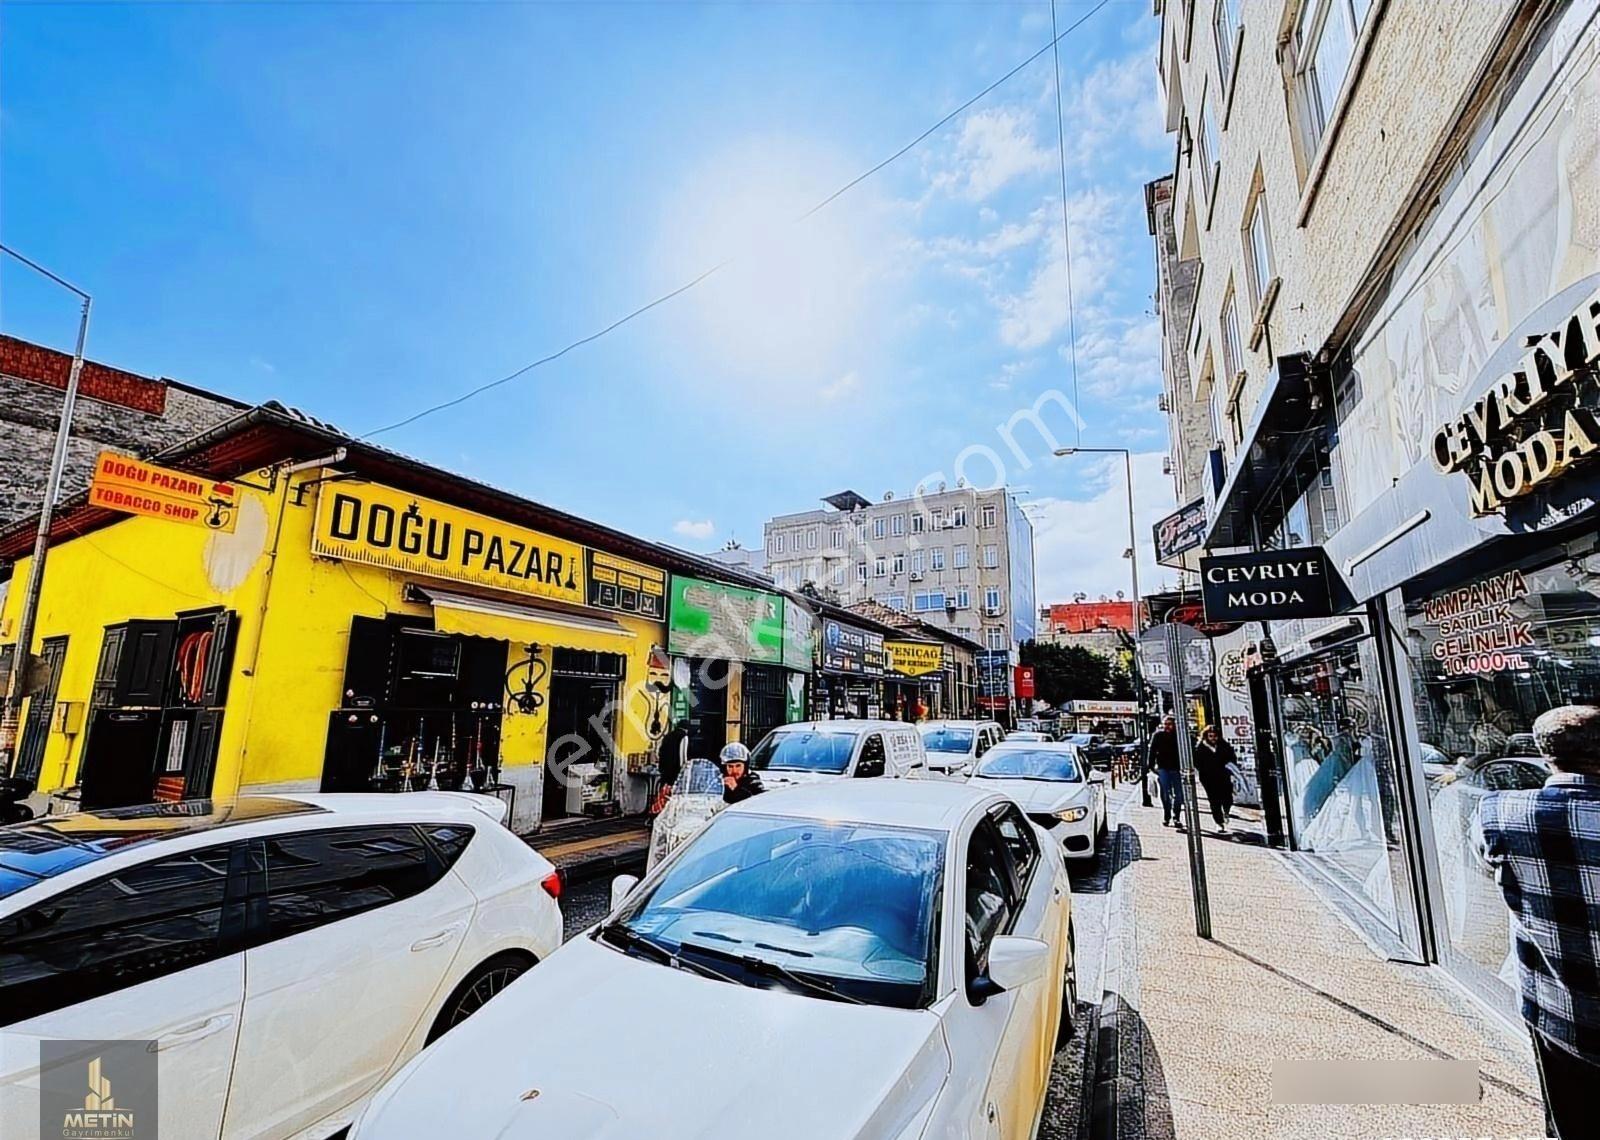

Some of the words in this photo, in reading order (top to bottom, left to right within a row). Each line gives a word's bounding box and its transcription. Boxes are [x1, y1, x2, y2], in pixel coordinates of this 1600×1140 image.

[1463, 409, 1597, 518] MODA
[151, 472, 204, 496] PAZARI
[96, 488, 161, 512] TOBACCO
[164, 503, 199, 520] SHOP
[1207, 560, 1320, 584] CEVRIYE
[1228, 590, 1304, 608] MODA
[1424, 570, 1528, 622] KAMPANYA
[1440, 603, 1512, 636] SATILIK
[1432, 621, 1535, 660] GELİNLİK
